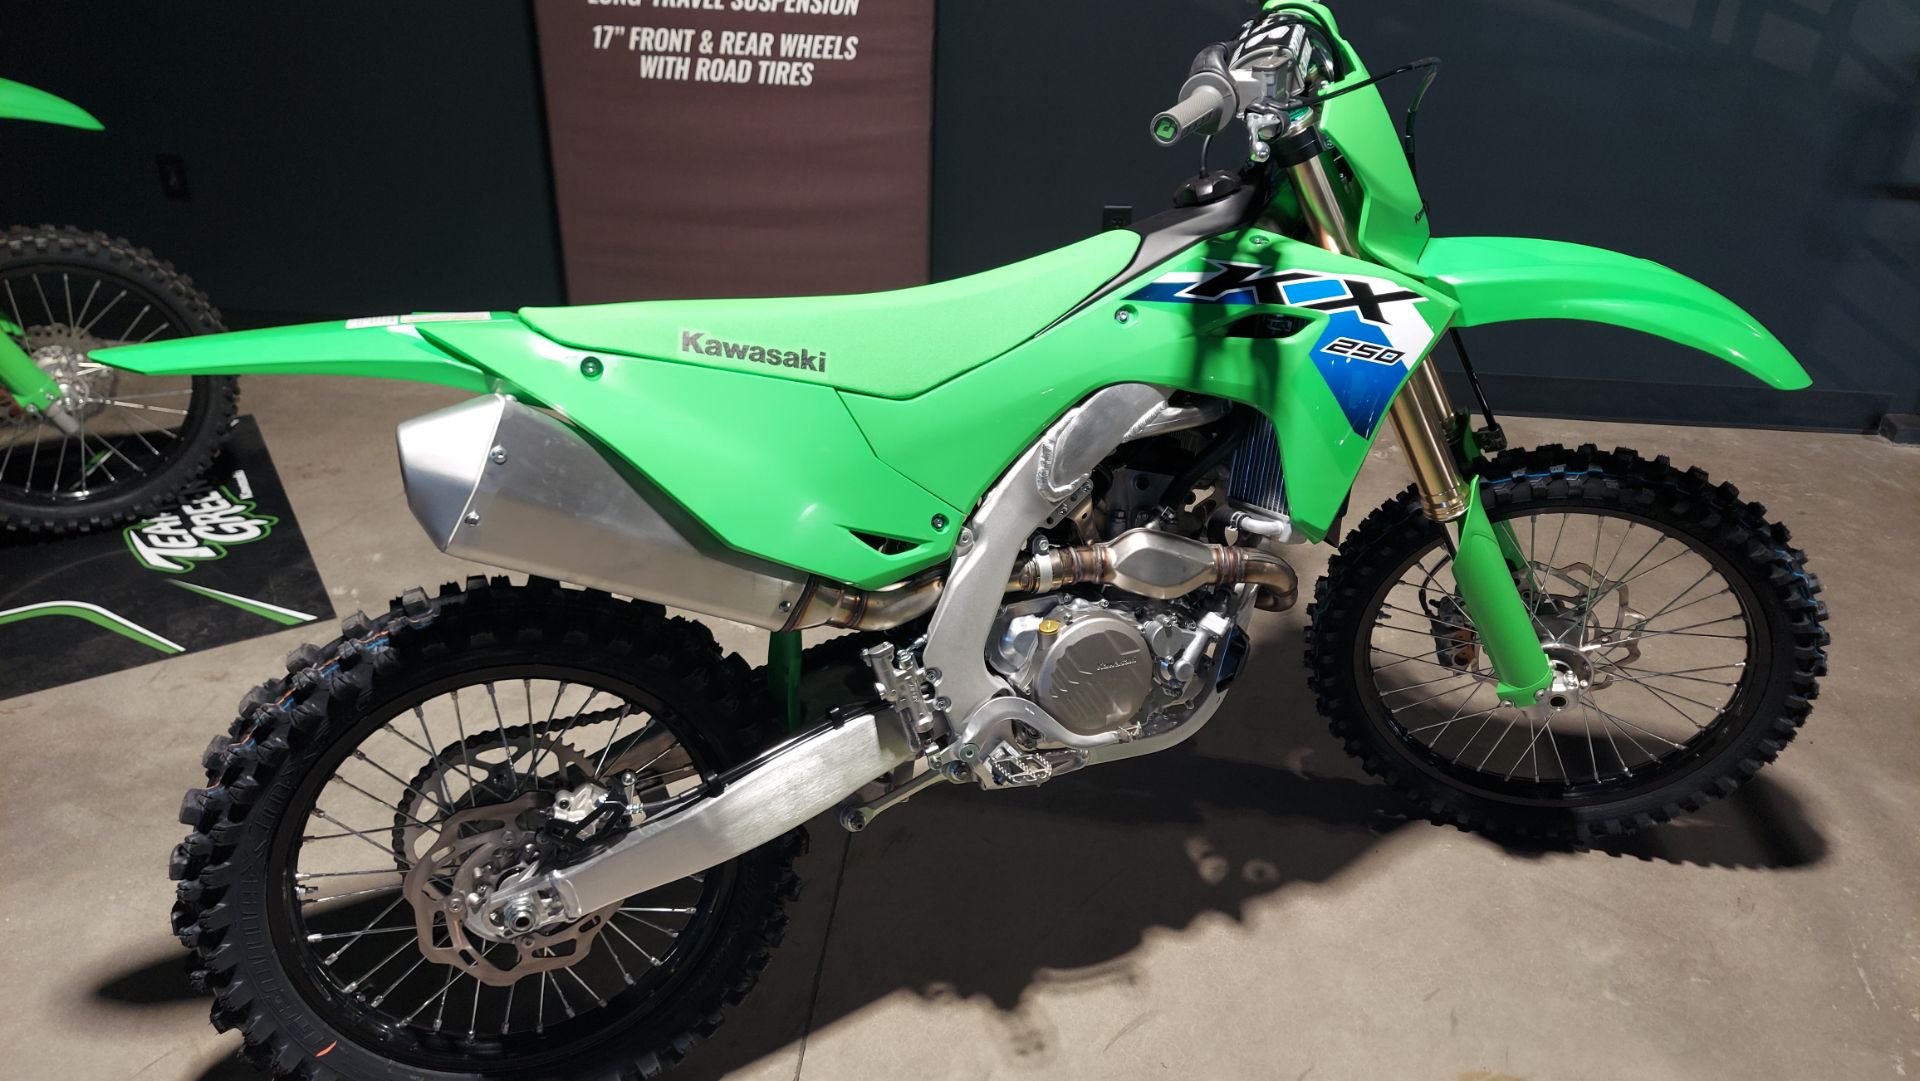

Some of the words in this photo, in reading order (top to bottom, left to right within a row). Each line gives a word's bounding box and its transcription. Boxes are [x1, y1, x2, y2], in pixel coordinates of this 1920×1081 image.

[629, 26, 696, 53] FRONT
[699, 29, 714, 54] &
[719, 30, 775, 57] REAR
[779, 33, 859, 60] WHEELS
[640, 54, 691, 80] WITH
[695, 57, 752, 83] ROAD
[758, 60, 814, 86] TIRES
[682, 331, 826, 372] Kawasaki
[1322, 338, 1406, 365] 250
